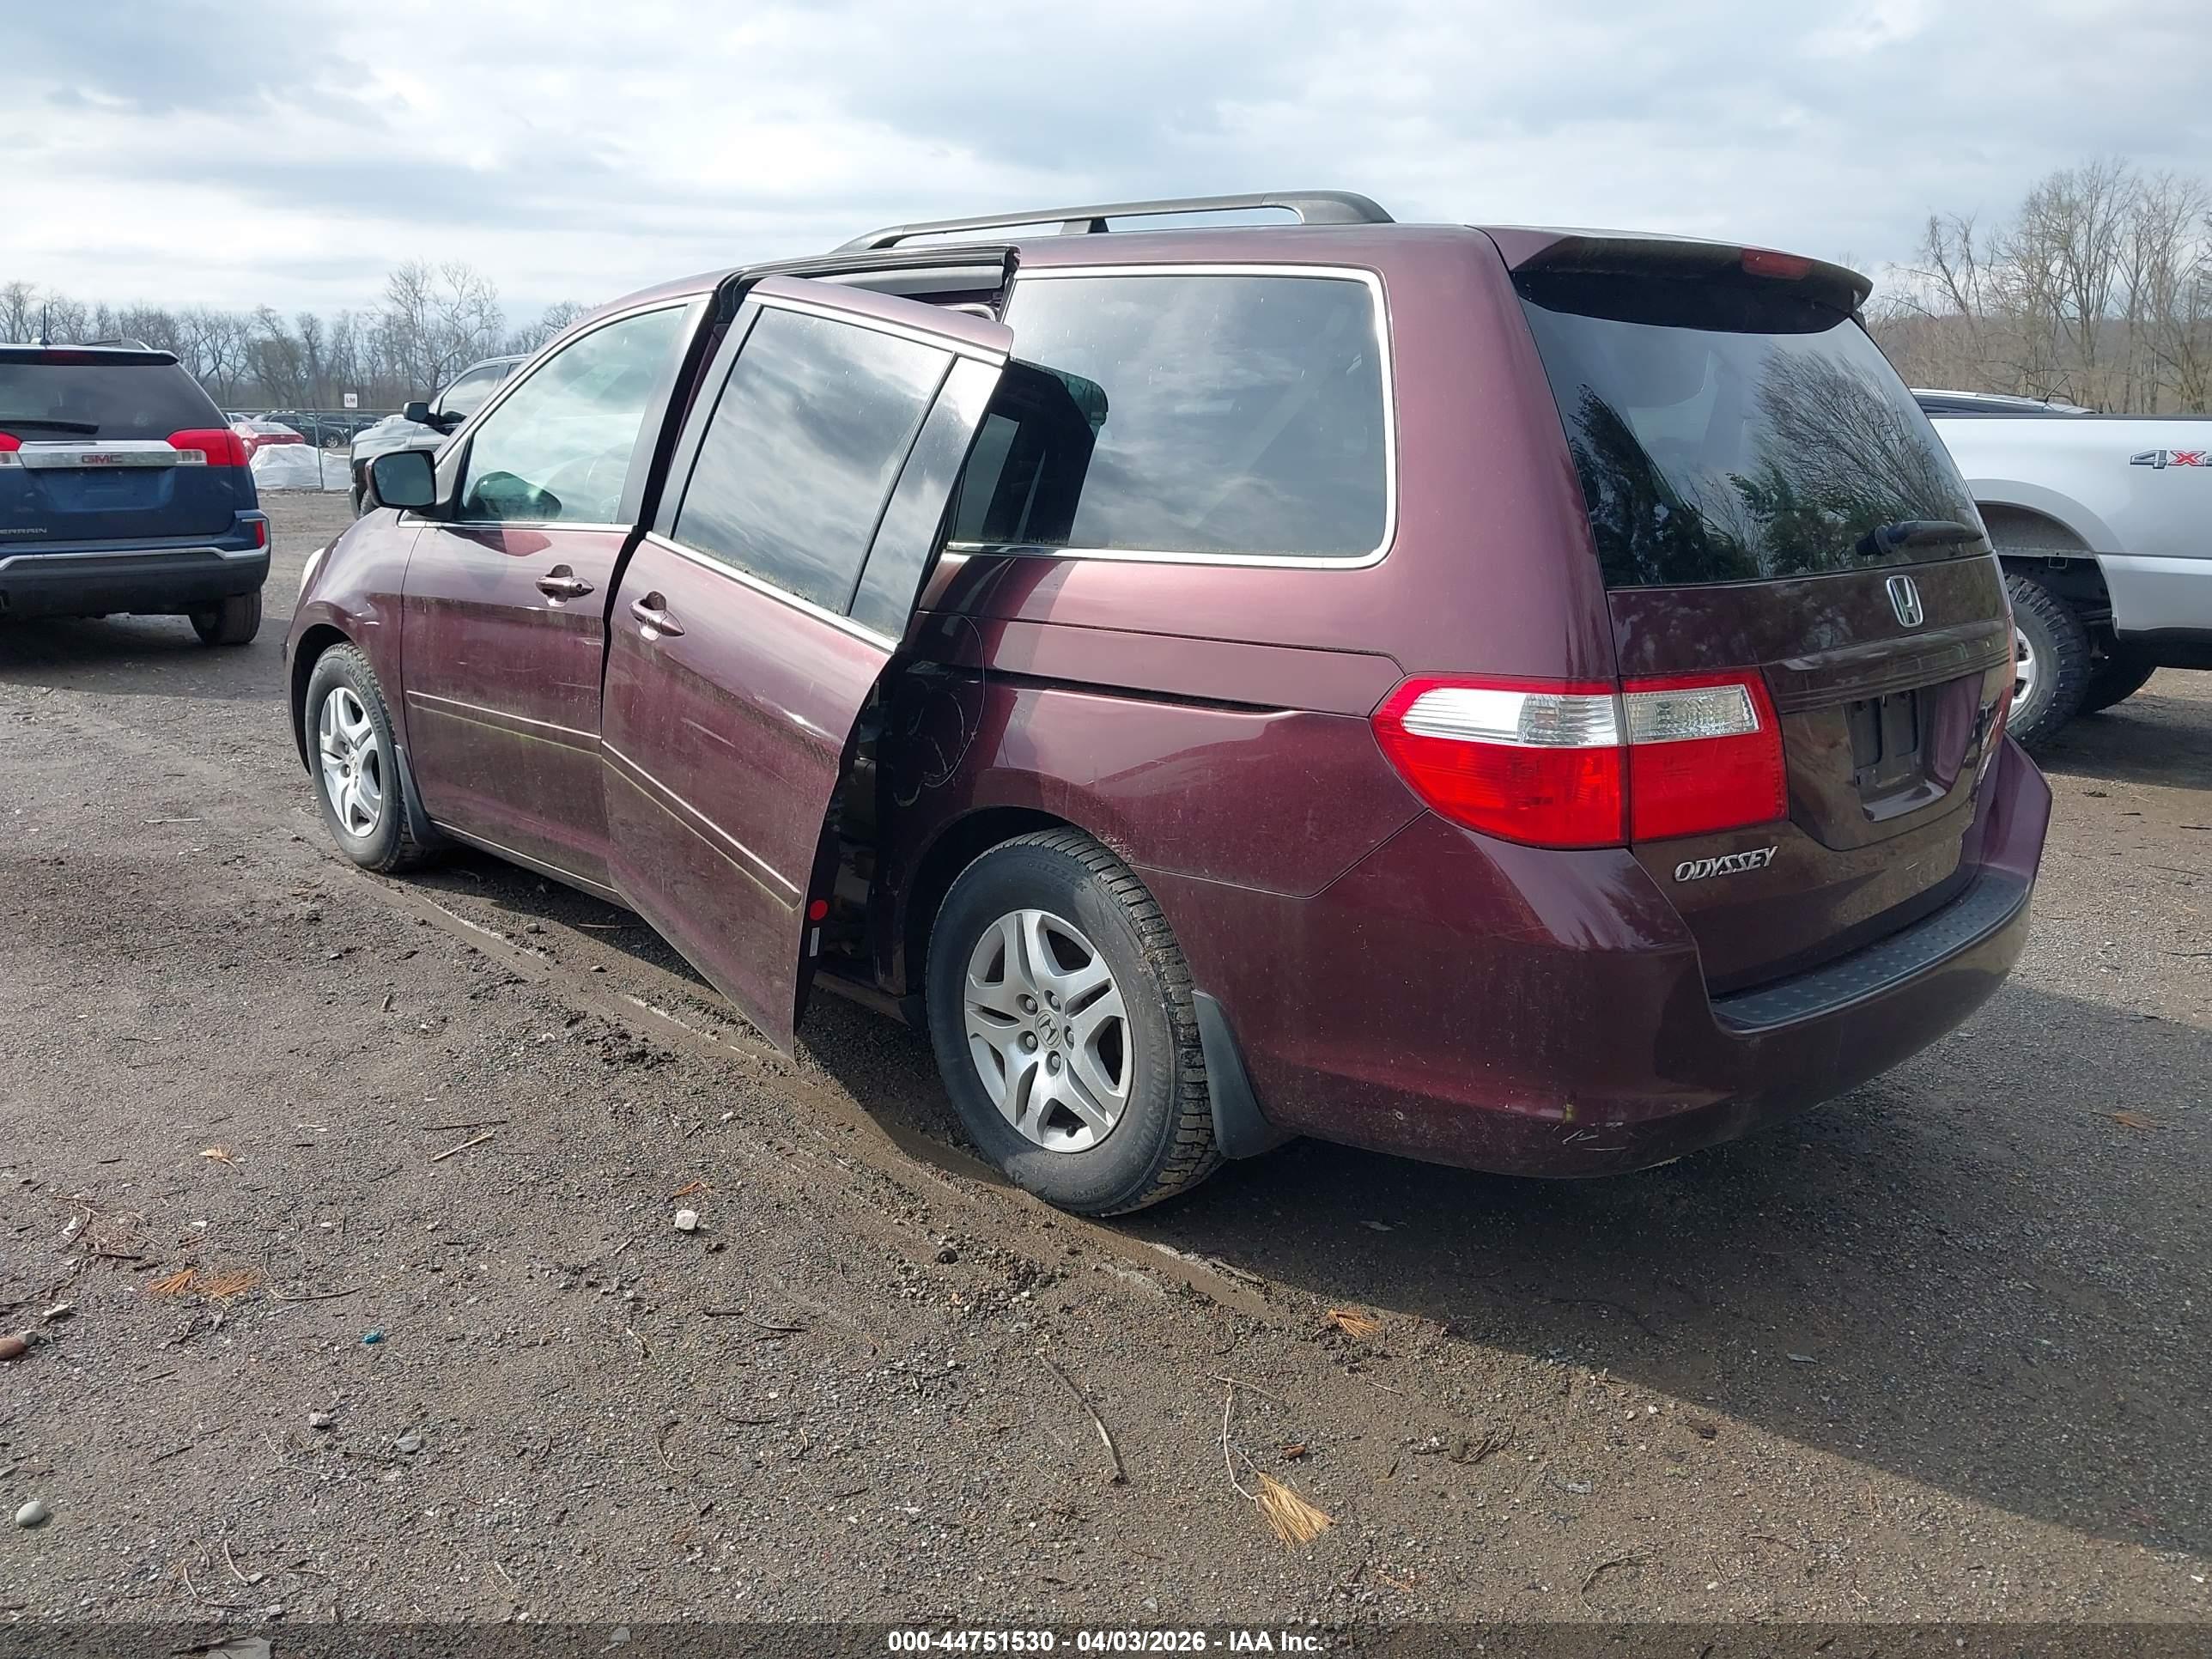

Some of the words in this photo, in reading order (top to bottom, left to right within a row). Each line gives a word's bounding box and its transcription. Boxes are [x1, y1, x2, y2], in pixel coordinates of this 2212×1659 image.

[82, 454, 124, 464] GMC
[2130, 449, 2212, 470] 4X
[1674, 846, 1778, 882] ODYSSEY
